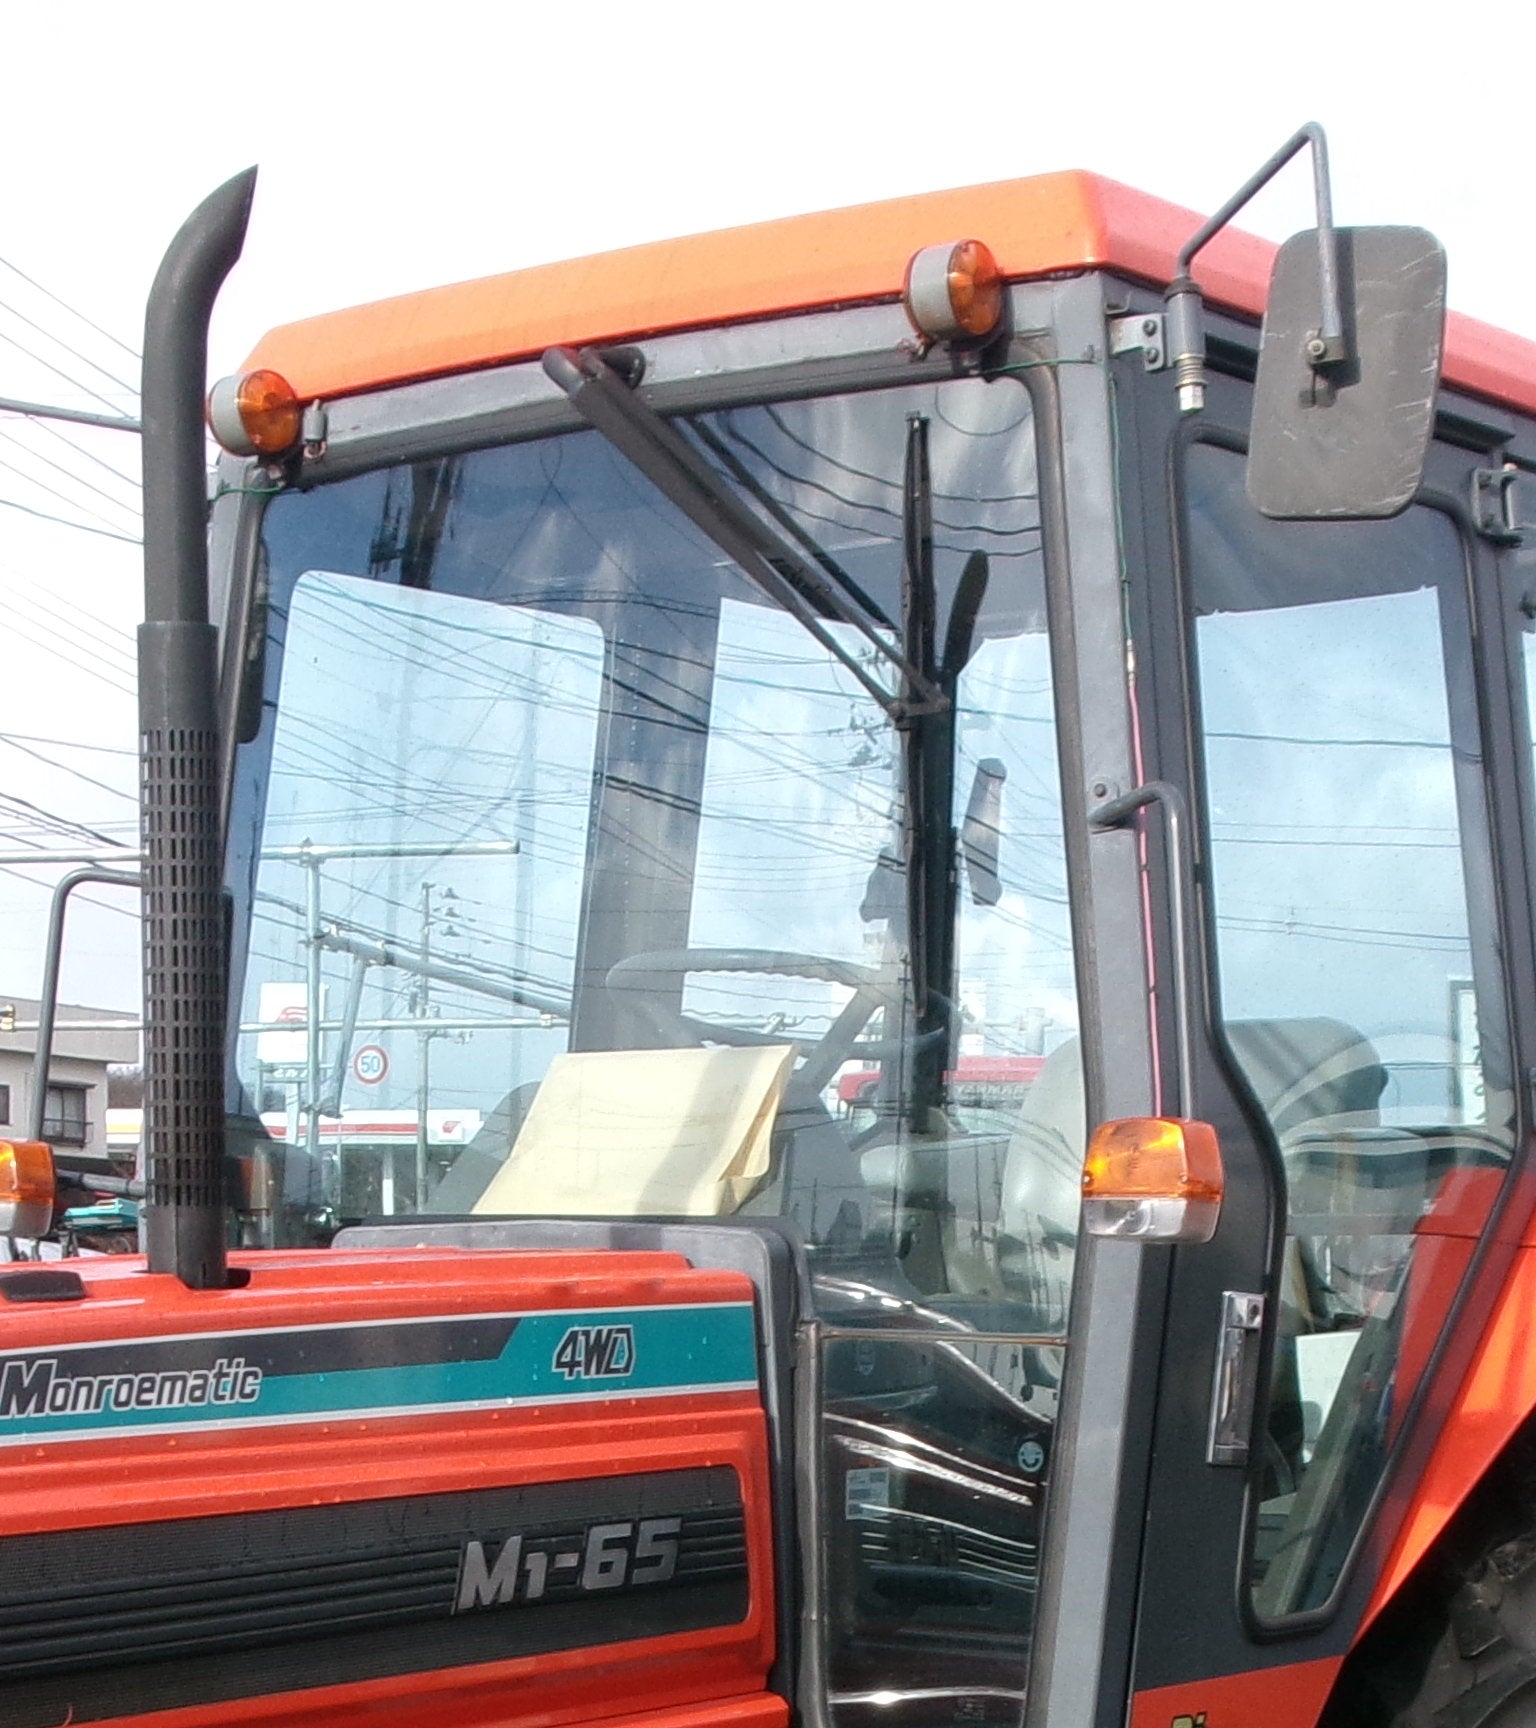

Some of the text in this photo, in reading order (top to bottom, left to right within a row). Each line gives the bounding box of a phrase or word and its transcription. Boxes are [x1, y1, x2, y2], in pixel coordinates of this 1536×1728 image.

[361, 1055, 381, 1073] 50
[552, 1324, 636, 1380] 4WD
[457, 1518, 682, 1610] M1-65
